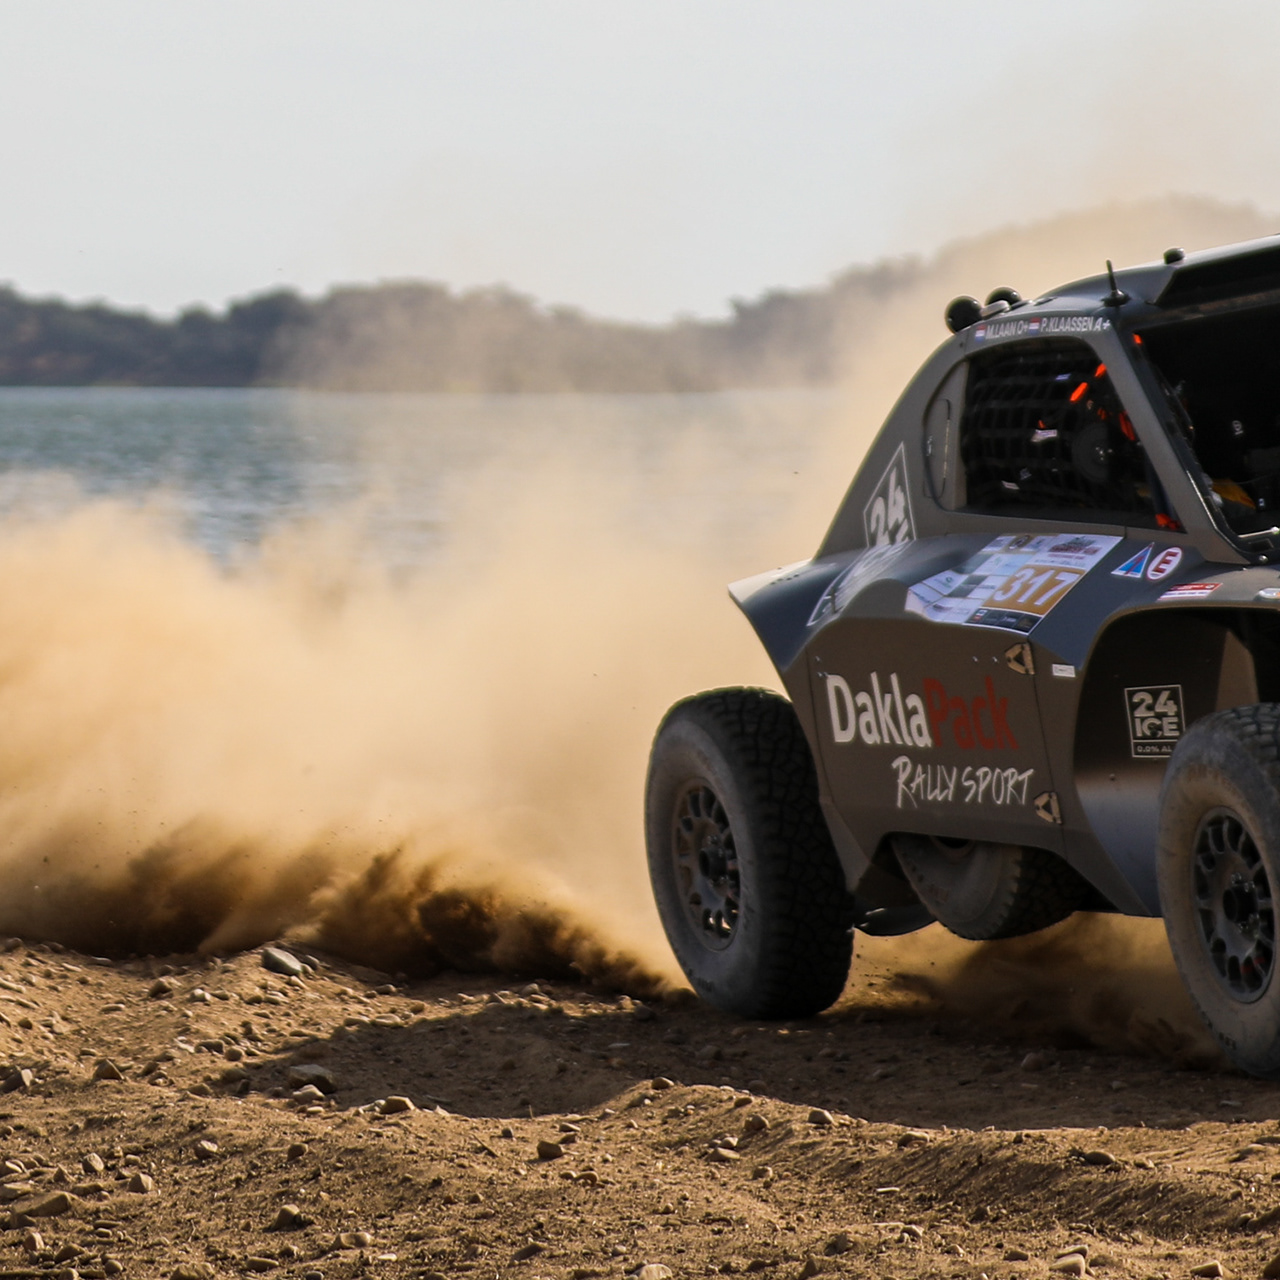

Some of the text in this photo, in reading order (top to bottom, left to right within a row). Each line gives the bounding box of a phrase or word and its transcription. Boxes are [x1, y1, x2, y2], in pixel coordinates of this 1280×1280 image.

[985, 322, 1016, 339] M.LAAN
[1040, 317, 1094, 332] P.KLAASSEN
[992, 567, 1080, 606] 317
[826, 671, 1020, 750] DaklaPack
[1132, 690, 1178, 717] 24
[1134, 717, 1180, 738] ICE
[891, 755, 1035, 808] RALLY SPORT
